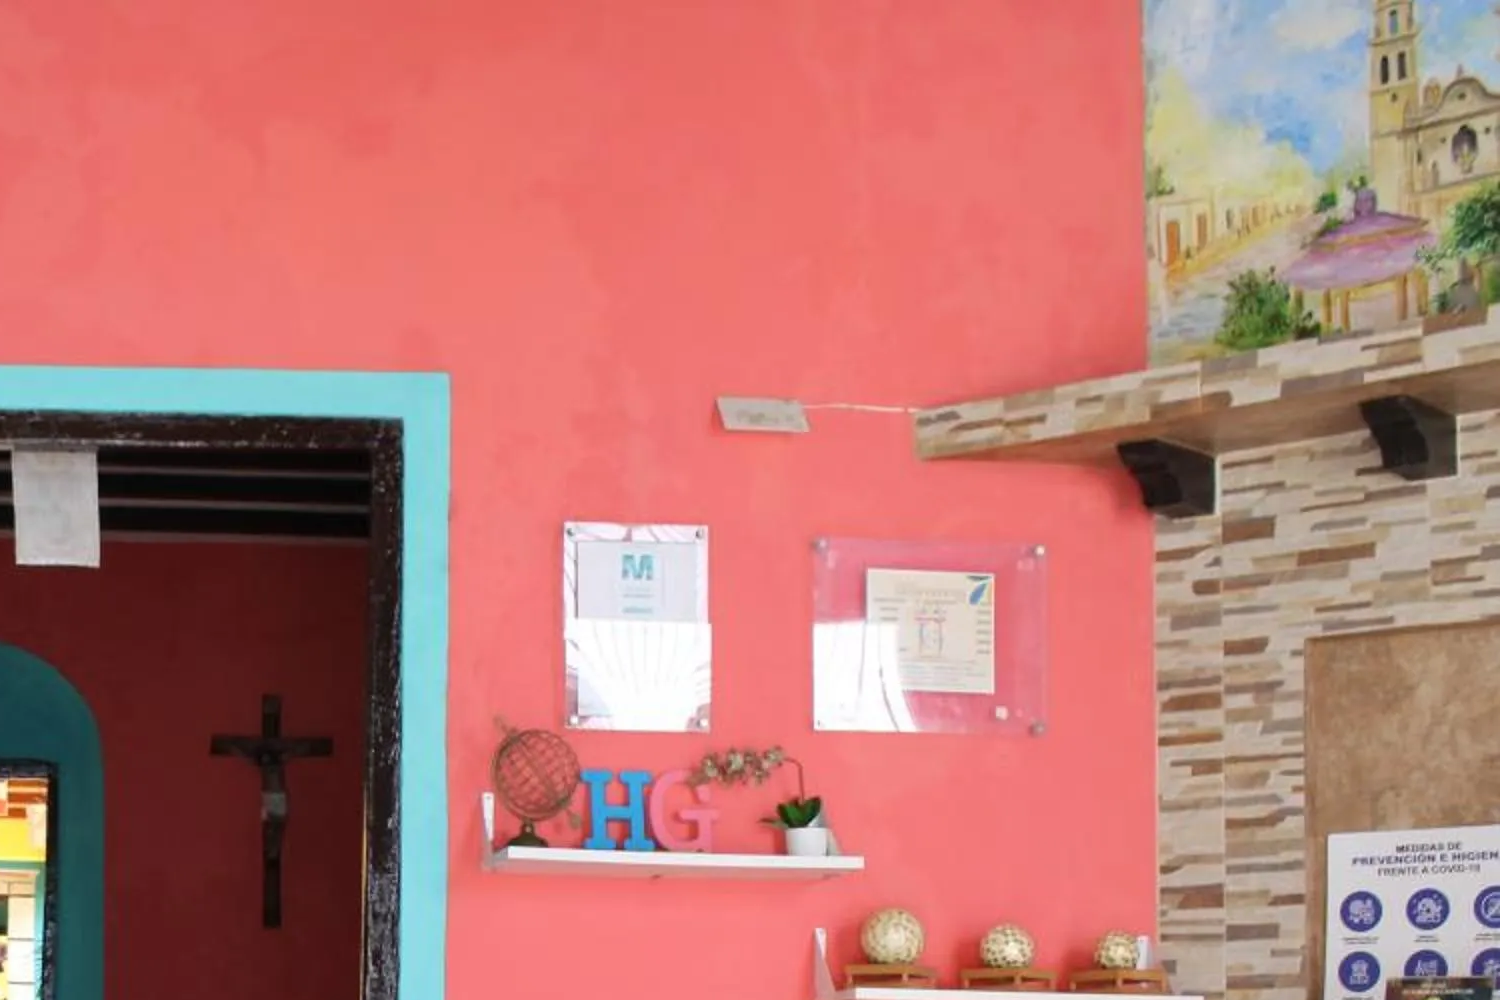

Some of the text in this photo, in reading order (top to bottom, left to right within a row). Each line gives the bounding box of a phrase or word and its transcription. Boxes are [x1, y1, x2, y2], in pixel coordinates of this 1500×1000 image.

[621, 554, 654, 581] M
[1396, 841, 1462, 853] MEDIDAS DE
[1440, 853, 1449, 862] E
[1451, 849, 1499, 862] HIGIEN
[1378, 866, 1419, 877] FRENTE
[1421, 865, 1429, 874] A
